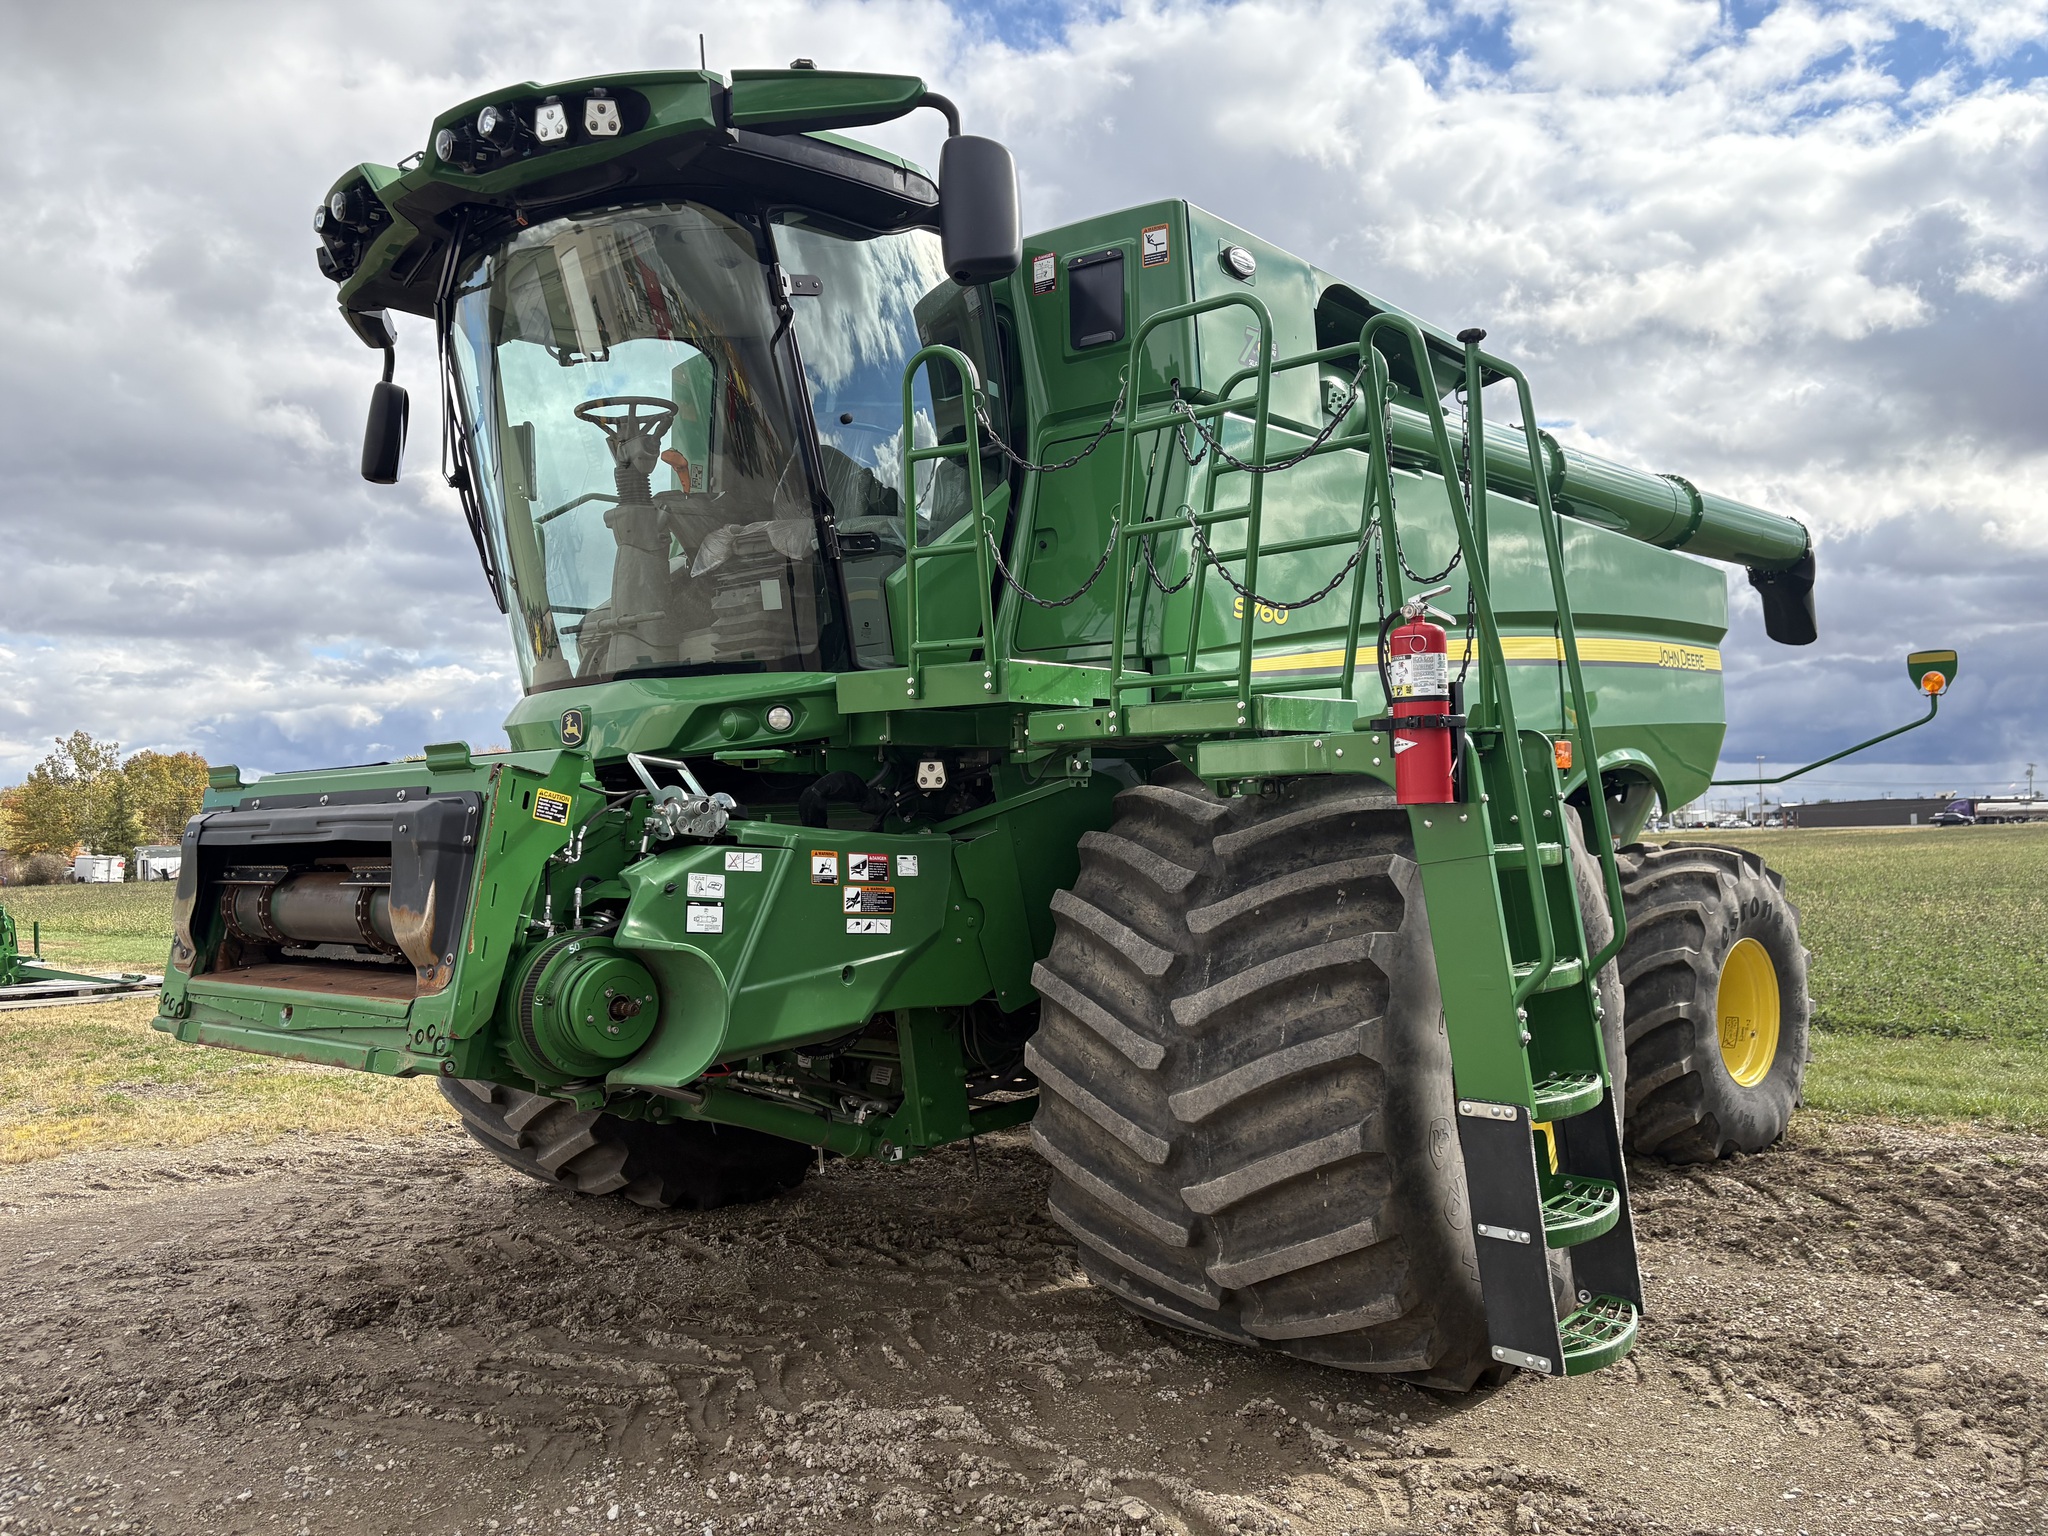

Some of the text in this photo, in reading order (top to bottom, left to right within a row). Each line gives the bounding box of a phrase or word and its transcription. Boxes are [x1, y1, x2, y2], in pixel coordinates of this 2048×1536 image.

[1658, 645, 1706, 670] JOHN DEERE
[543, 791, 570, 803] CAUTION
[569, 942, 580, 954] 50
